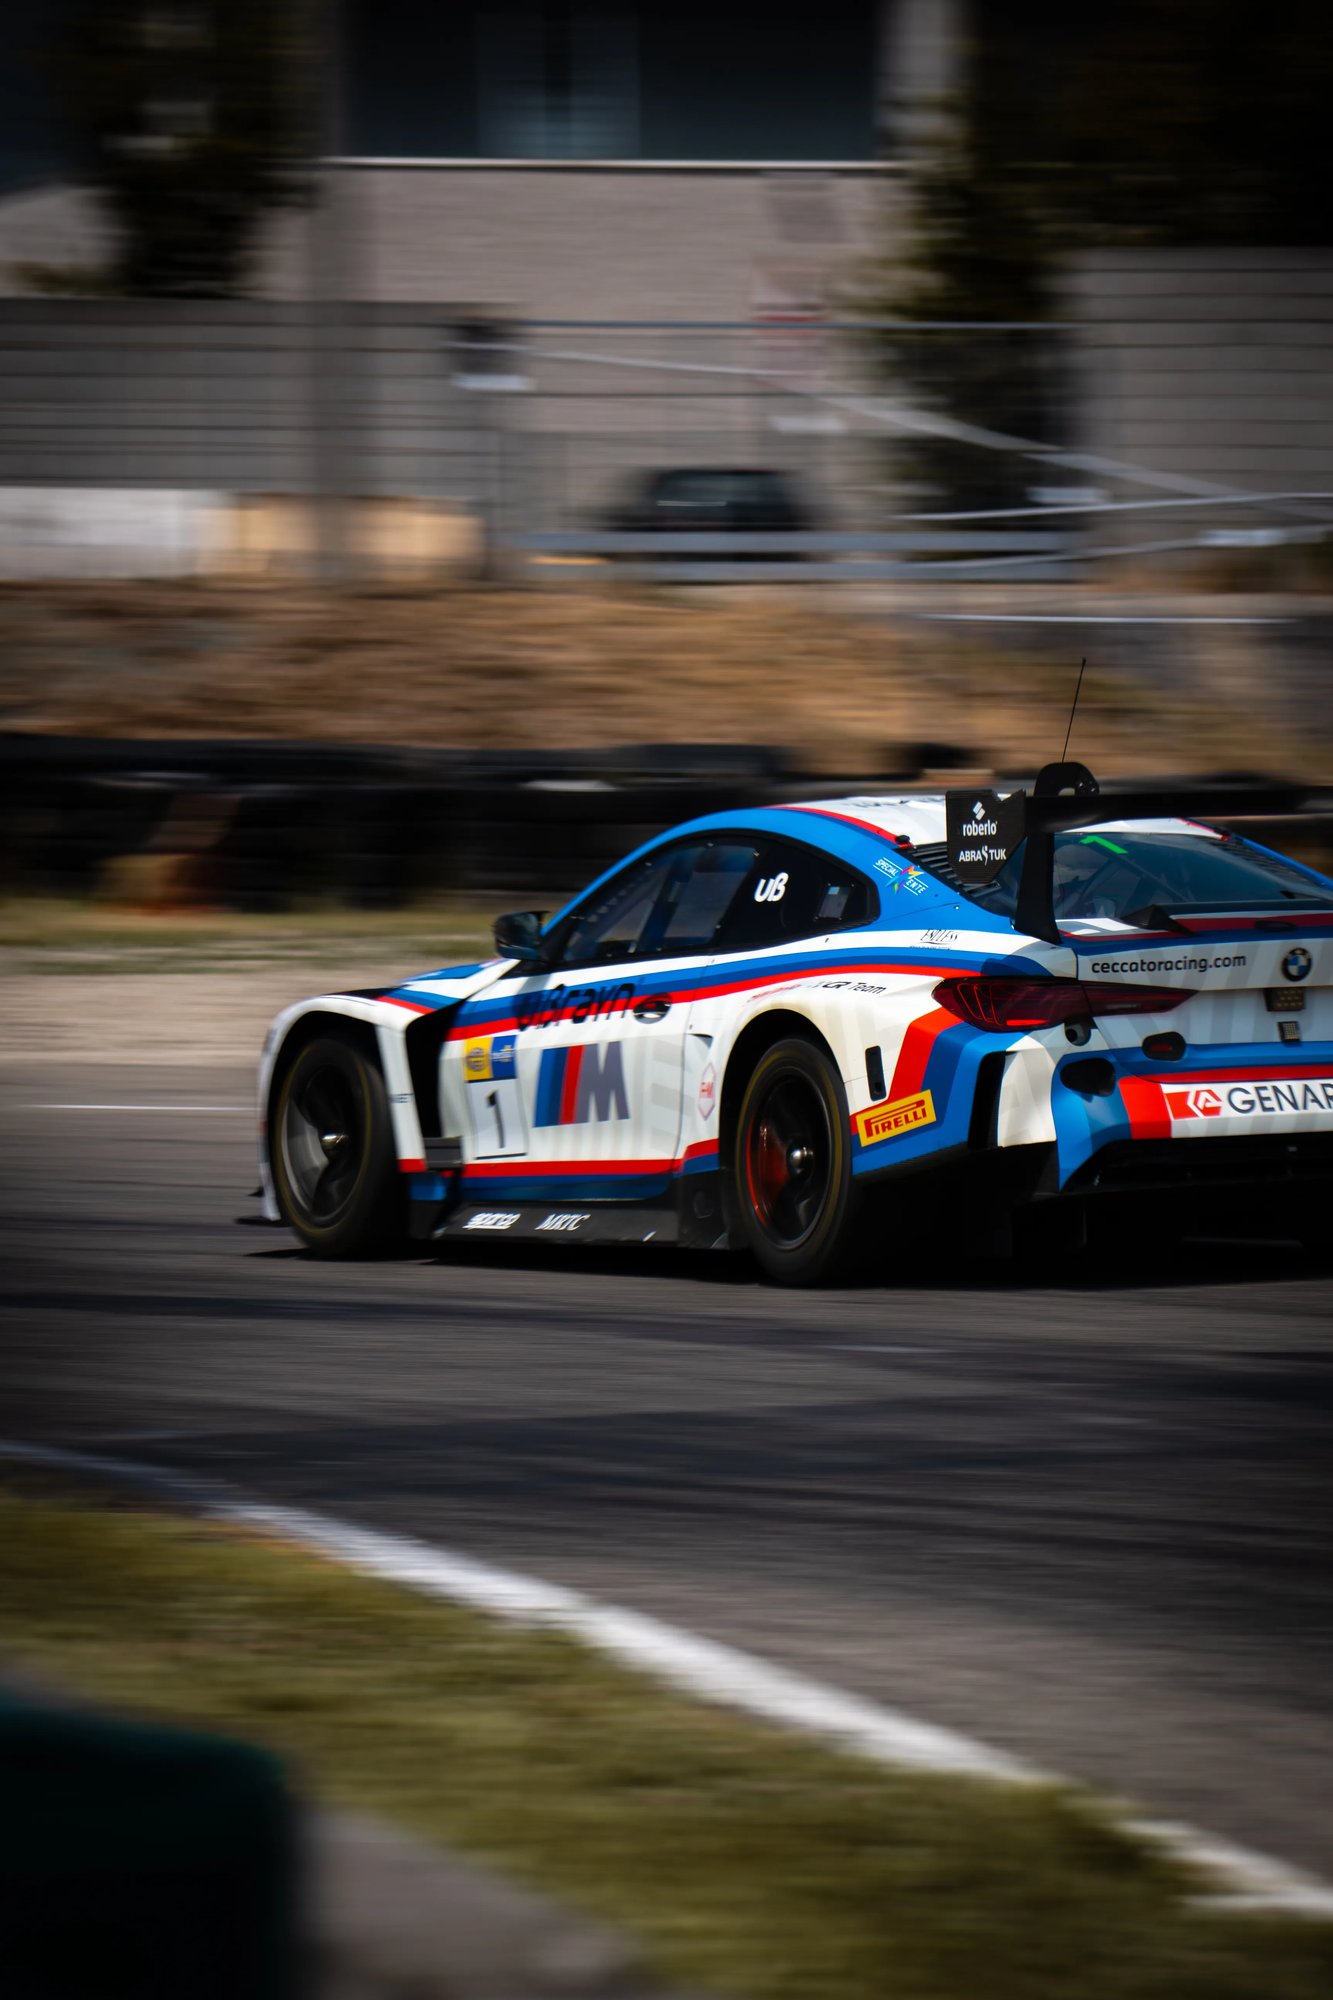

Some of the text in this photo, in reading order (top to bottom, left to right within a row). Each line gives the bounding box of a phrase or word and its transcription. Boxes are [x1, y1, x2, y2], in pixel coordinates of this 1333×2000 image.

[962, 819, 997, 837] roberlo
[875, 859, 899, 876] SPECIAL
[1091, 955, 1247, 974] ceccatoracing.com
[487, 1090, 505, 1149] 1
[863, 1099, 927, 1138] PIRELLI
